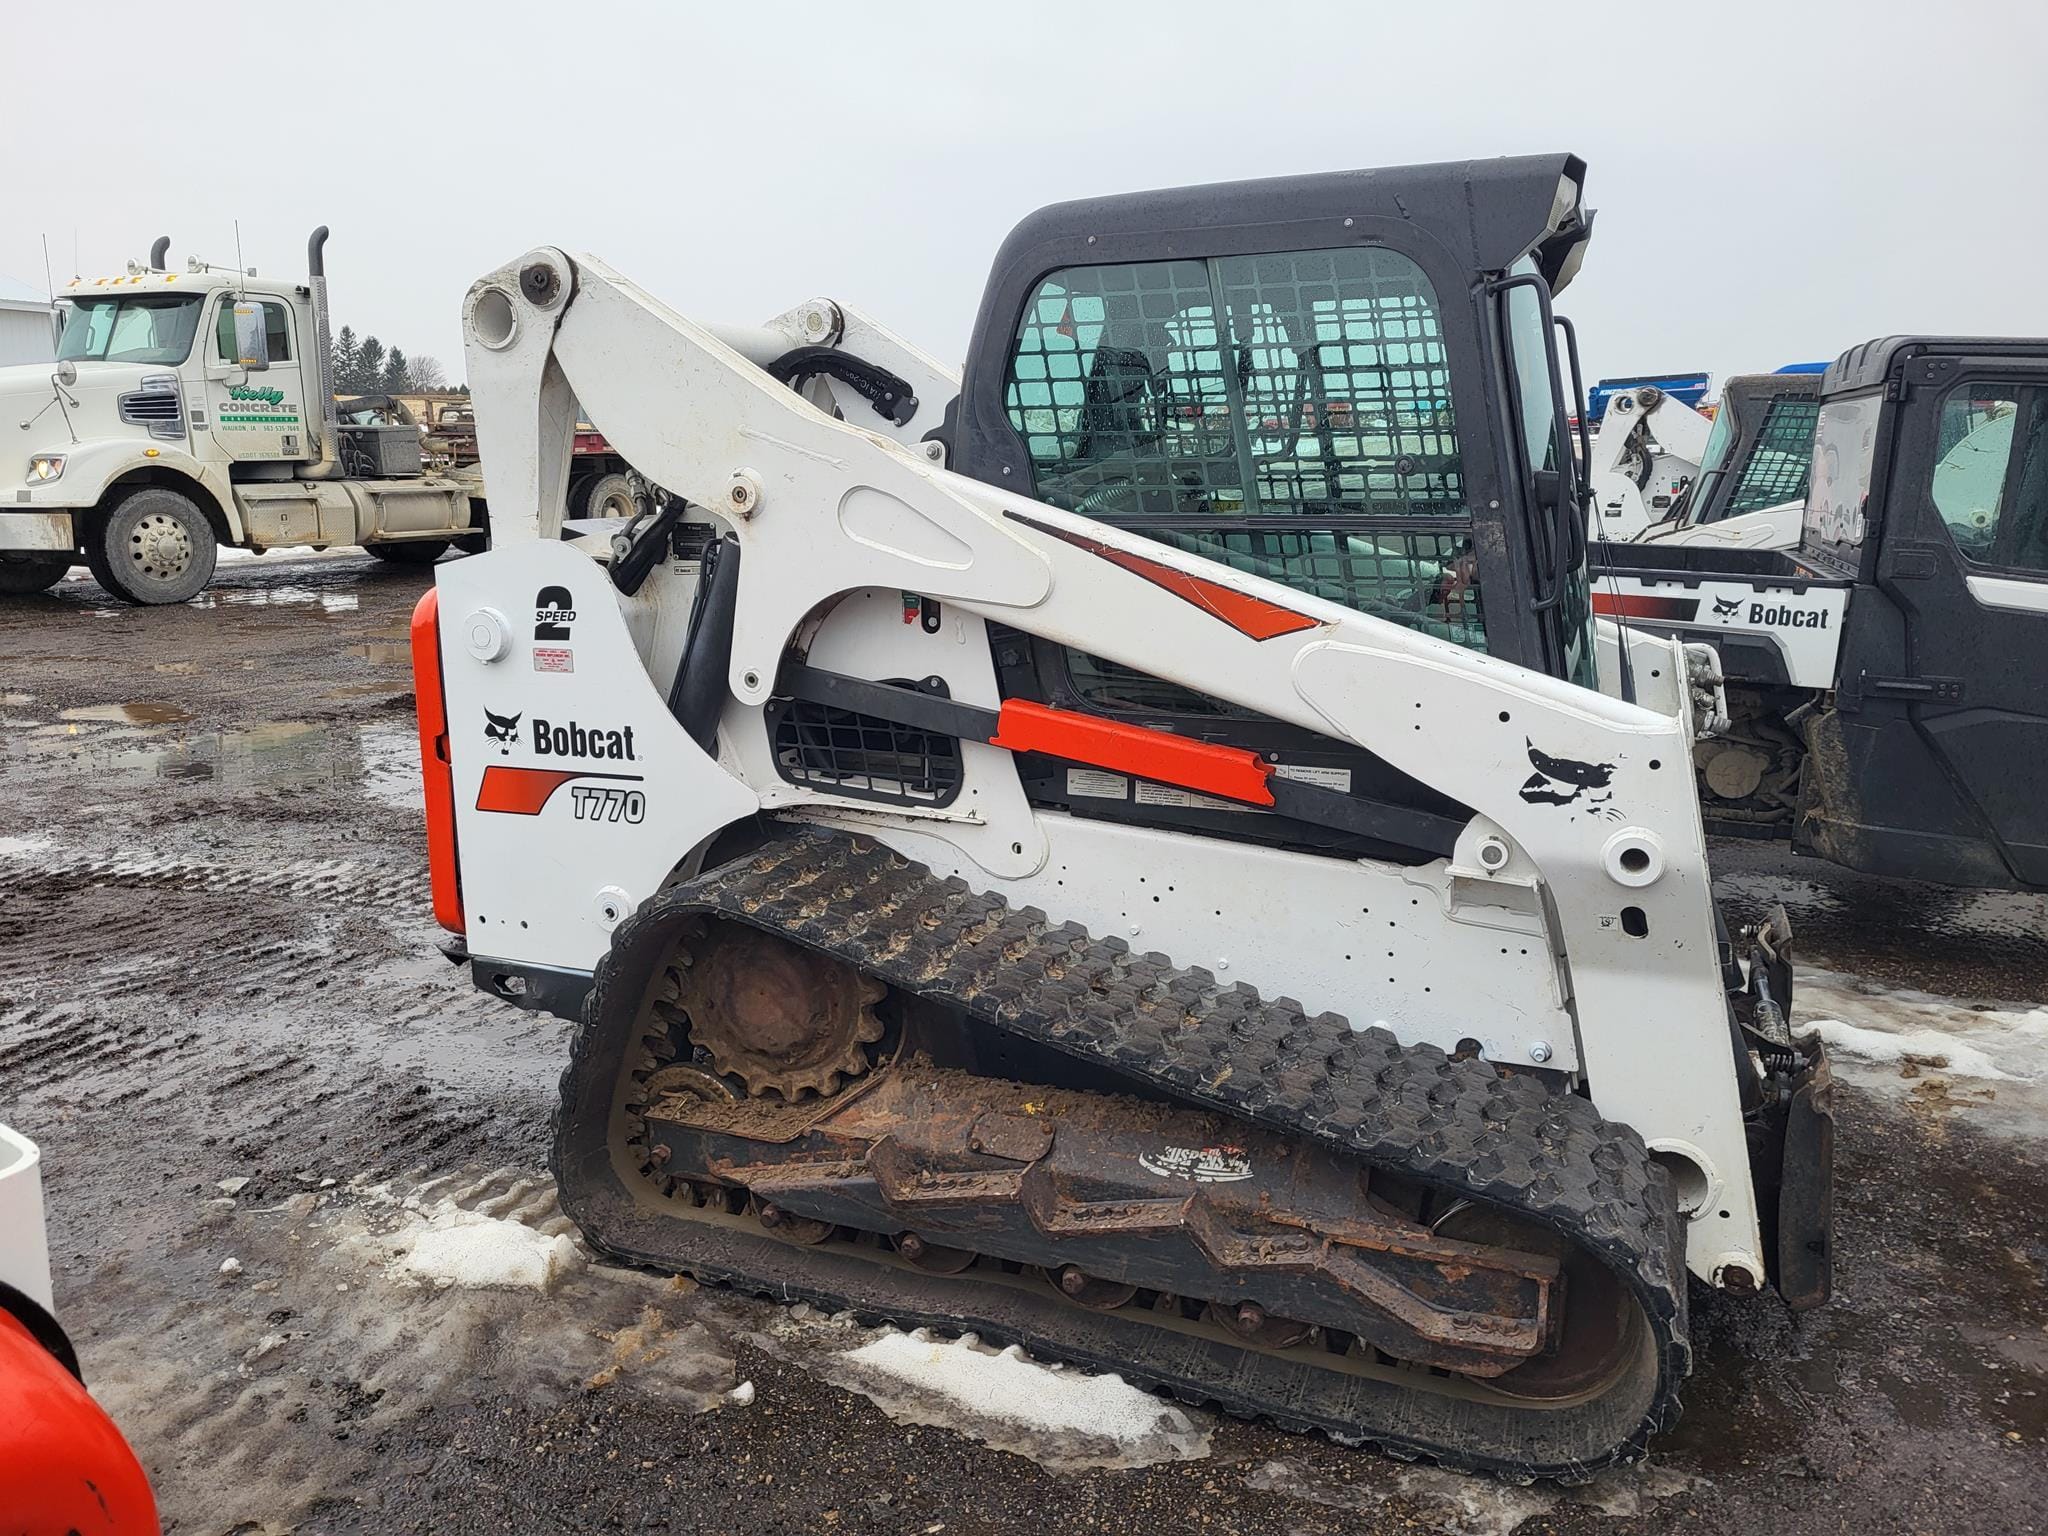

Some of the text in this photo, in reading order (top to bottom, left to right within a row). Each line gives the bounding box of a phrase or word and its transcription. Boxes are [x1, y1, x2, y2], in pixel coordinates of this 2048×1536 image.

[218, 403, 298, 413] CONCRETE
[229, 386, 284, 406] Kelly
[534, 585, 573, 641] 2
[535, 610, 577, 622] SPEED
[1749, 603, 1829, 629] Bobcat
[532, 719, 636, 761] Bobcat
[571, 786, 646, 825] T770
